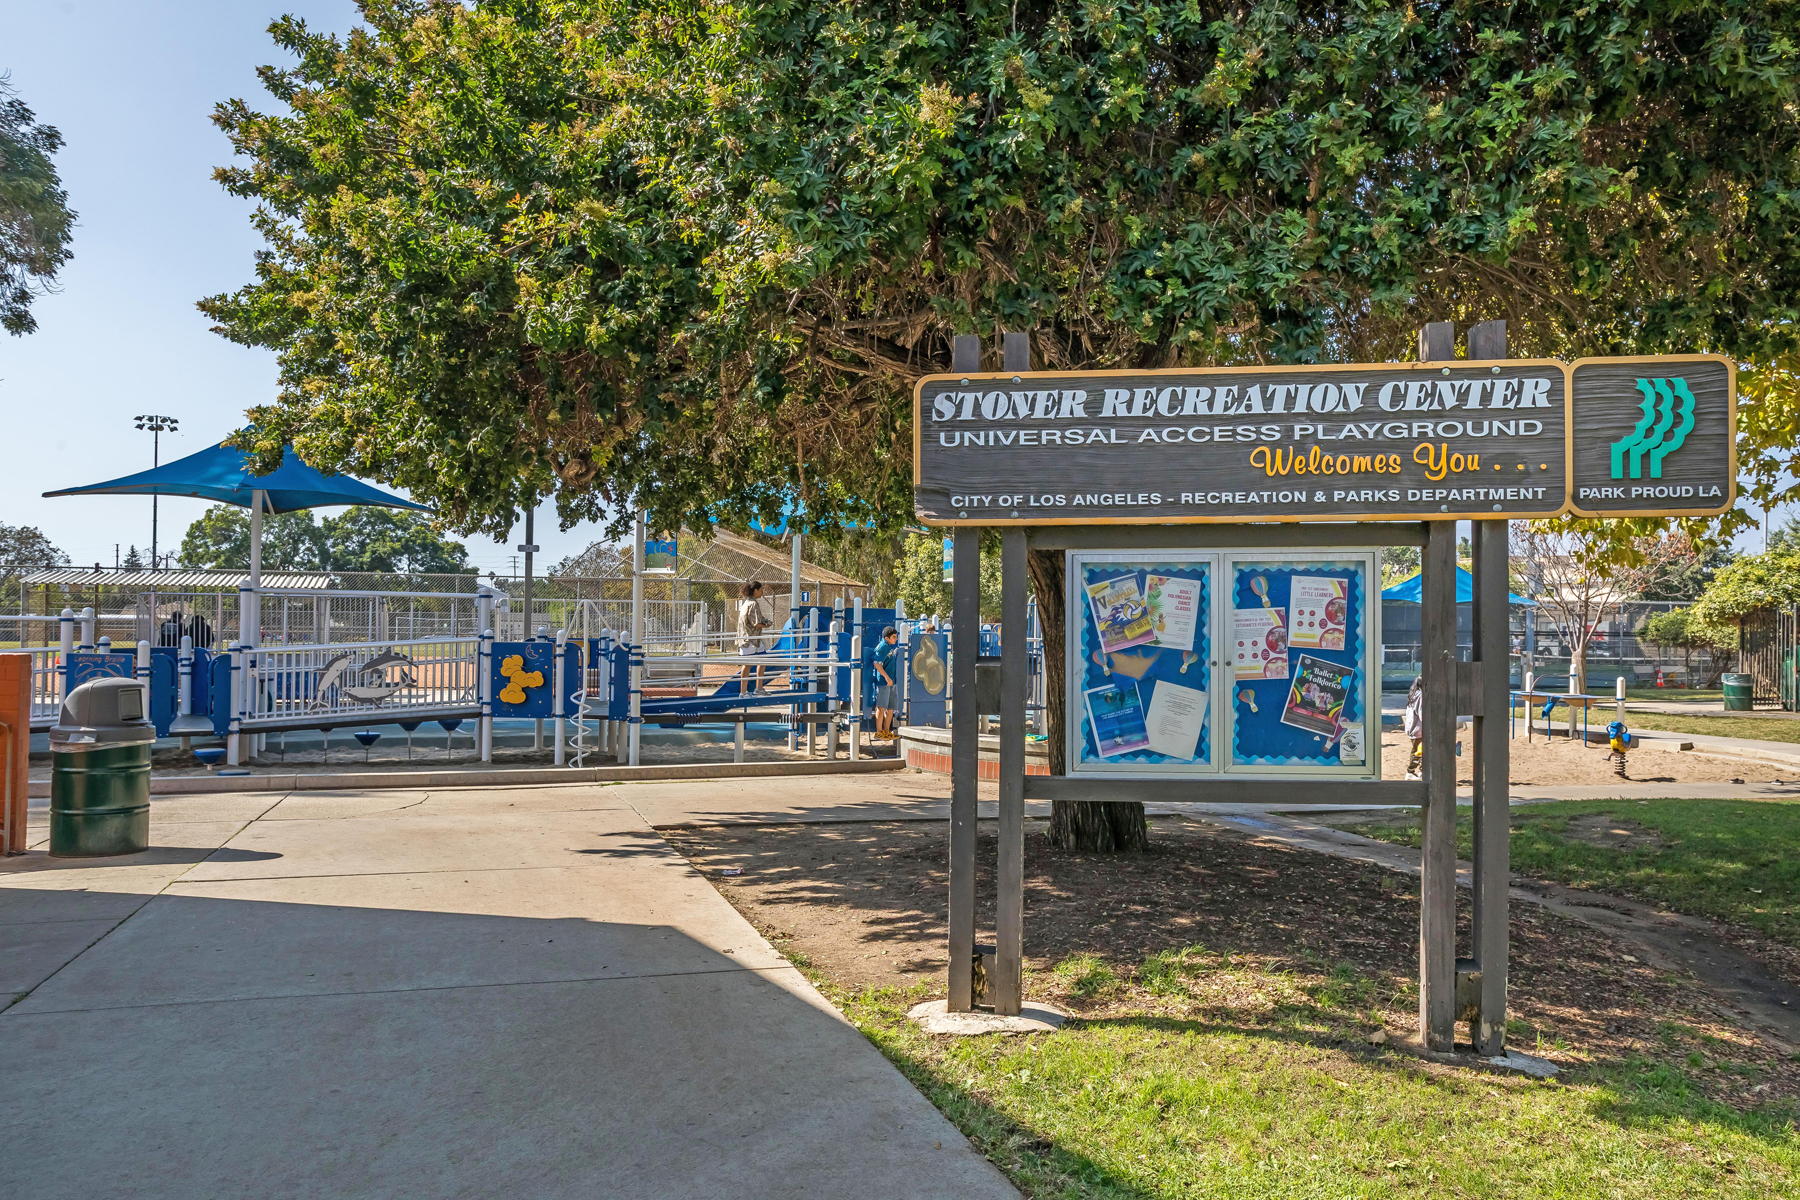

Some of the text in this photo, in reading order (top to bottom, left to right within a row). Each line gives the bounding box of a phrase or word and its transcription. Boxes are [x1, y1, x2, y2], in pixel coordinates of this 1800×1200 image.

[932, 378, 1552, 422] STONER RECREATION CENTER
[939, 420, 1544, 448] UNIVERSAL ACCESS PLAYGROUND
[1249, 445, 1402, 477] Welcomes
[1412, 442, 1480, 482] You
[951, 494, 993, 508] CITY
[999, 494, 1024, 507] OF
[1029, 494, 1067, 506] LOS
[1073, 492, 1162, 506] ANGELES
[1181, 490, 1307, 505] RECREATION
[1314, 491, 1327, 503] &
[1333, 489, 1400, 503] PARKS
[1408, 487, 1547, 502] DEPARTMENT
[1579, 485, 1723, 500] PARK PROUD LA
[803, 592, 807, 601] 1
[74, 655, 102, 663] Learning
[1313, 667, 1334, 678] Ballet
